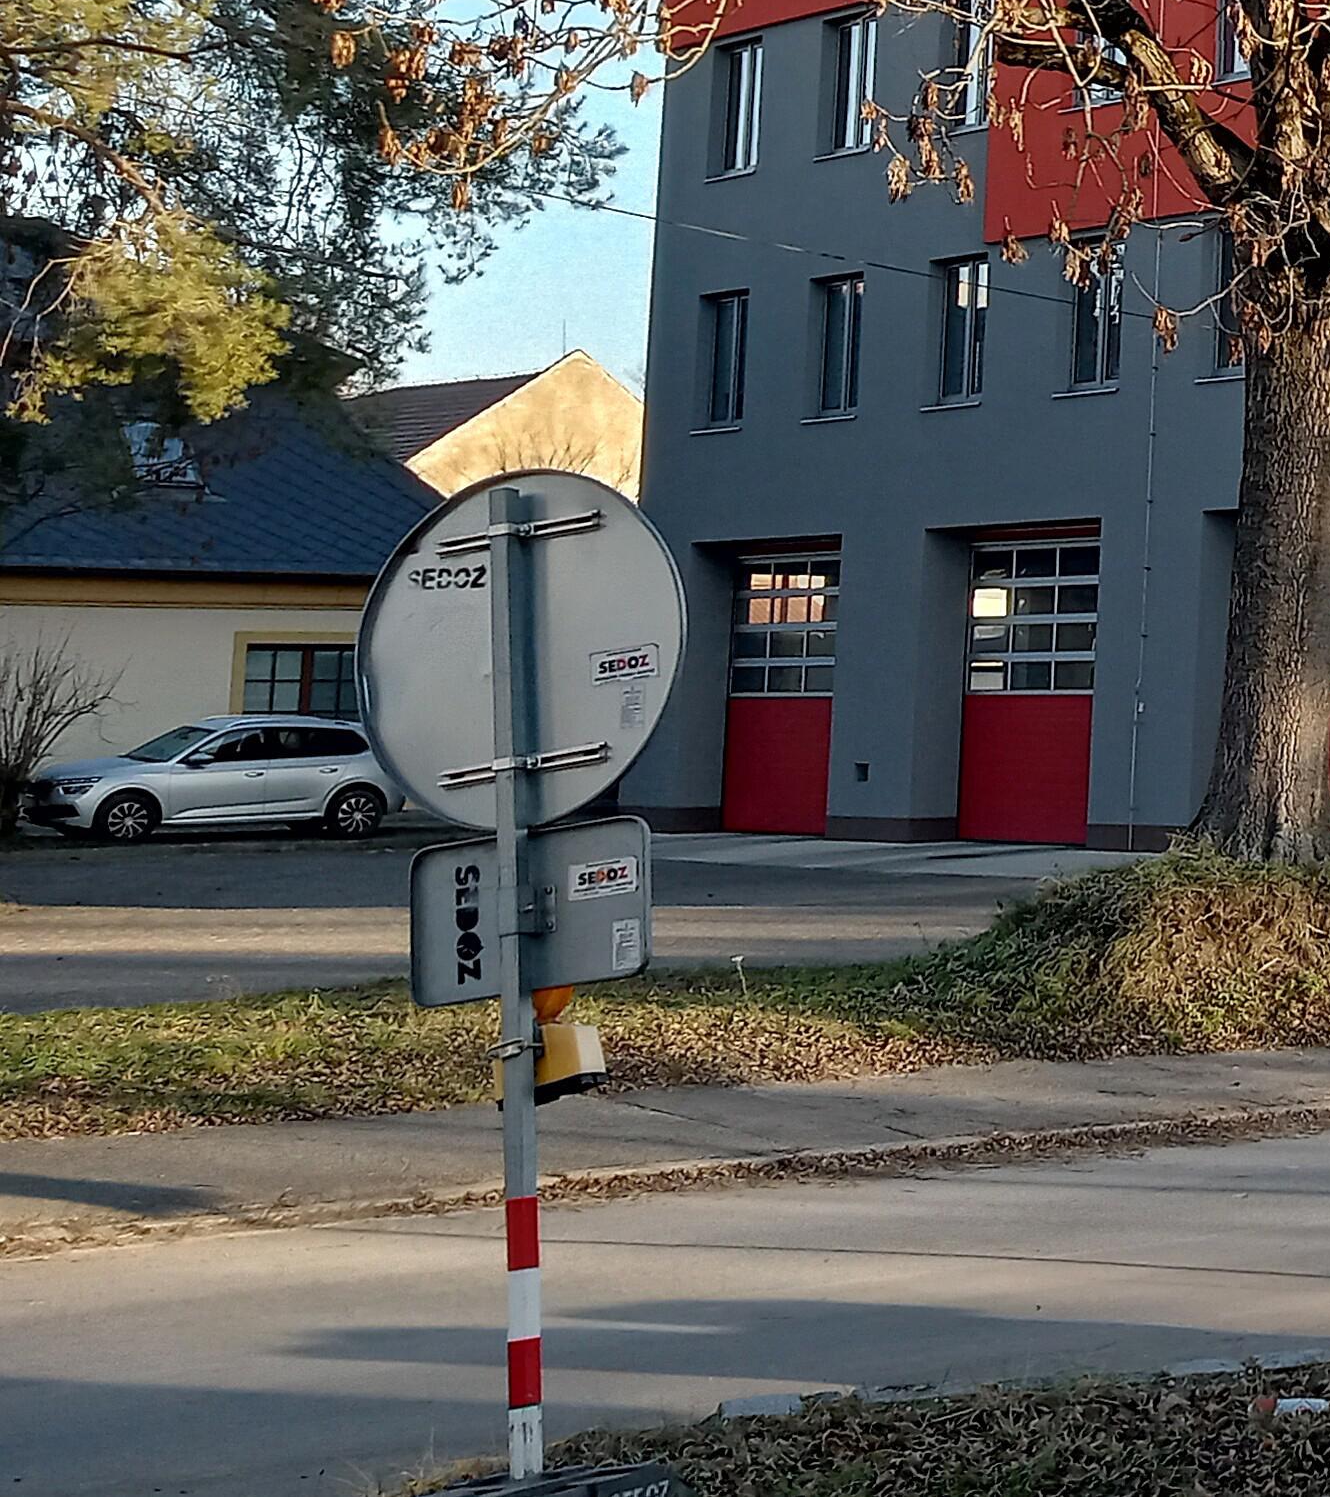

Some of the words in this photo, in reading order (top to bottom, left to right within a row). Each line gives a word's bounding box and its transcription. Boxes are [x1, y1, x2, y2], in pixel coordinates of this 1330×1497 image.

[408, 564, 487, 590] SEDOZ
[598, 653, 650, 675] SEDOZ
[577, 865, 629, 886] SEDOZ
[455, 865, 484, 985] SEDOZ
